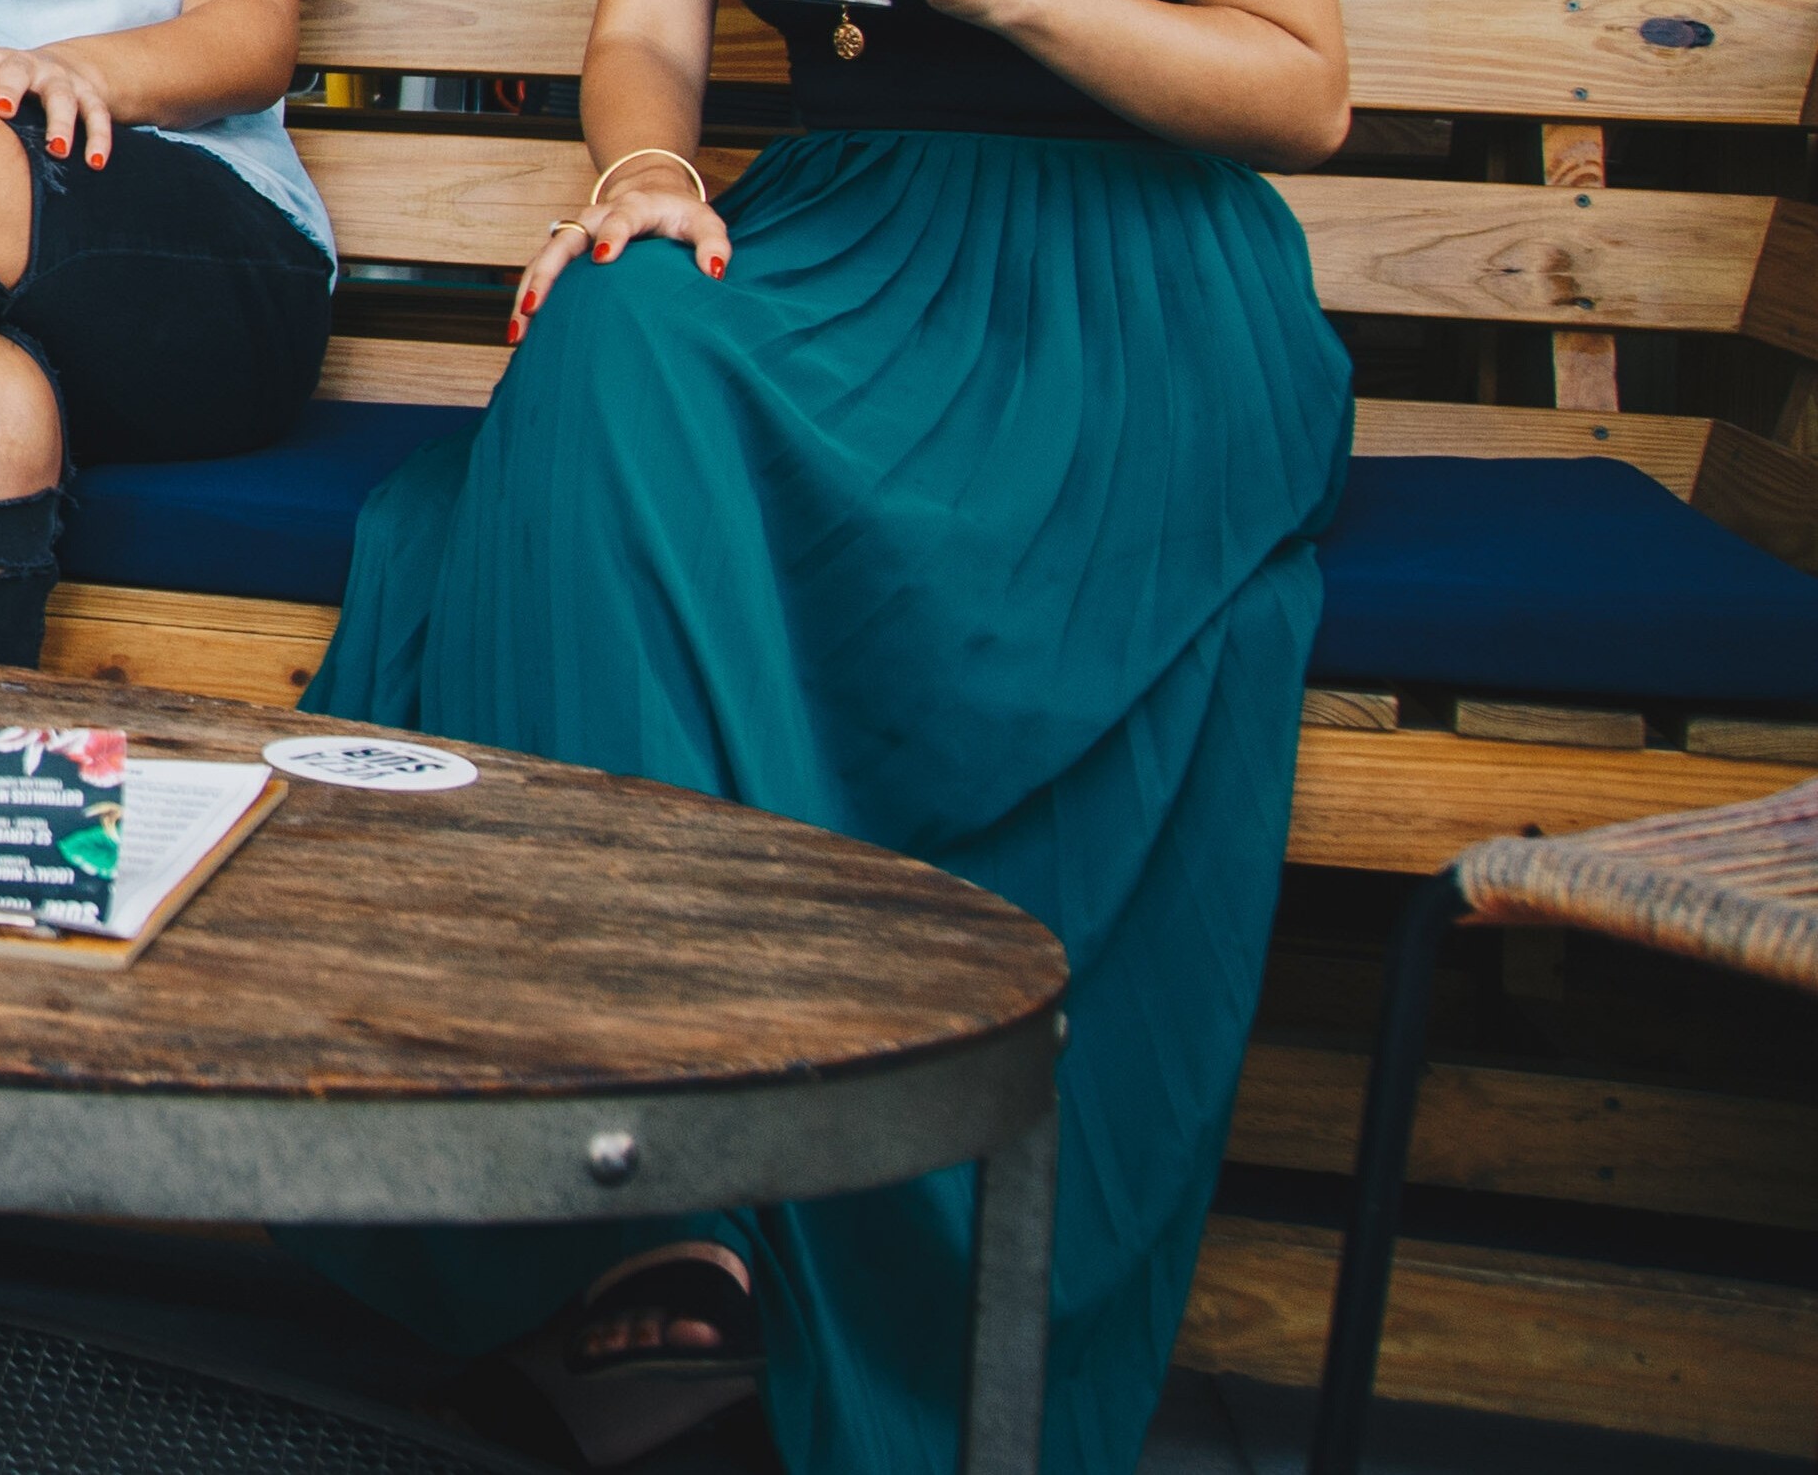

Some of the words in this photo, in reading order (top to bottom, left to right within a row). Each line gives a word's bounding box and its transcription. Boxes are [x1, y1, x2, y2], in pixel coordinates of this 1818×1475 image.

[291, 751, 393, 780] VEZA
[341, 747, 447, 775] SUR
[11, 789, 84, 807] BOTTOMLESS
